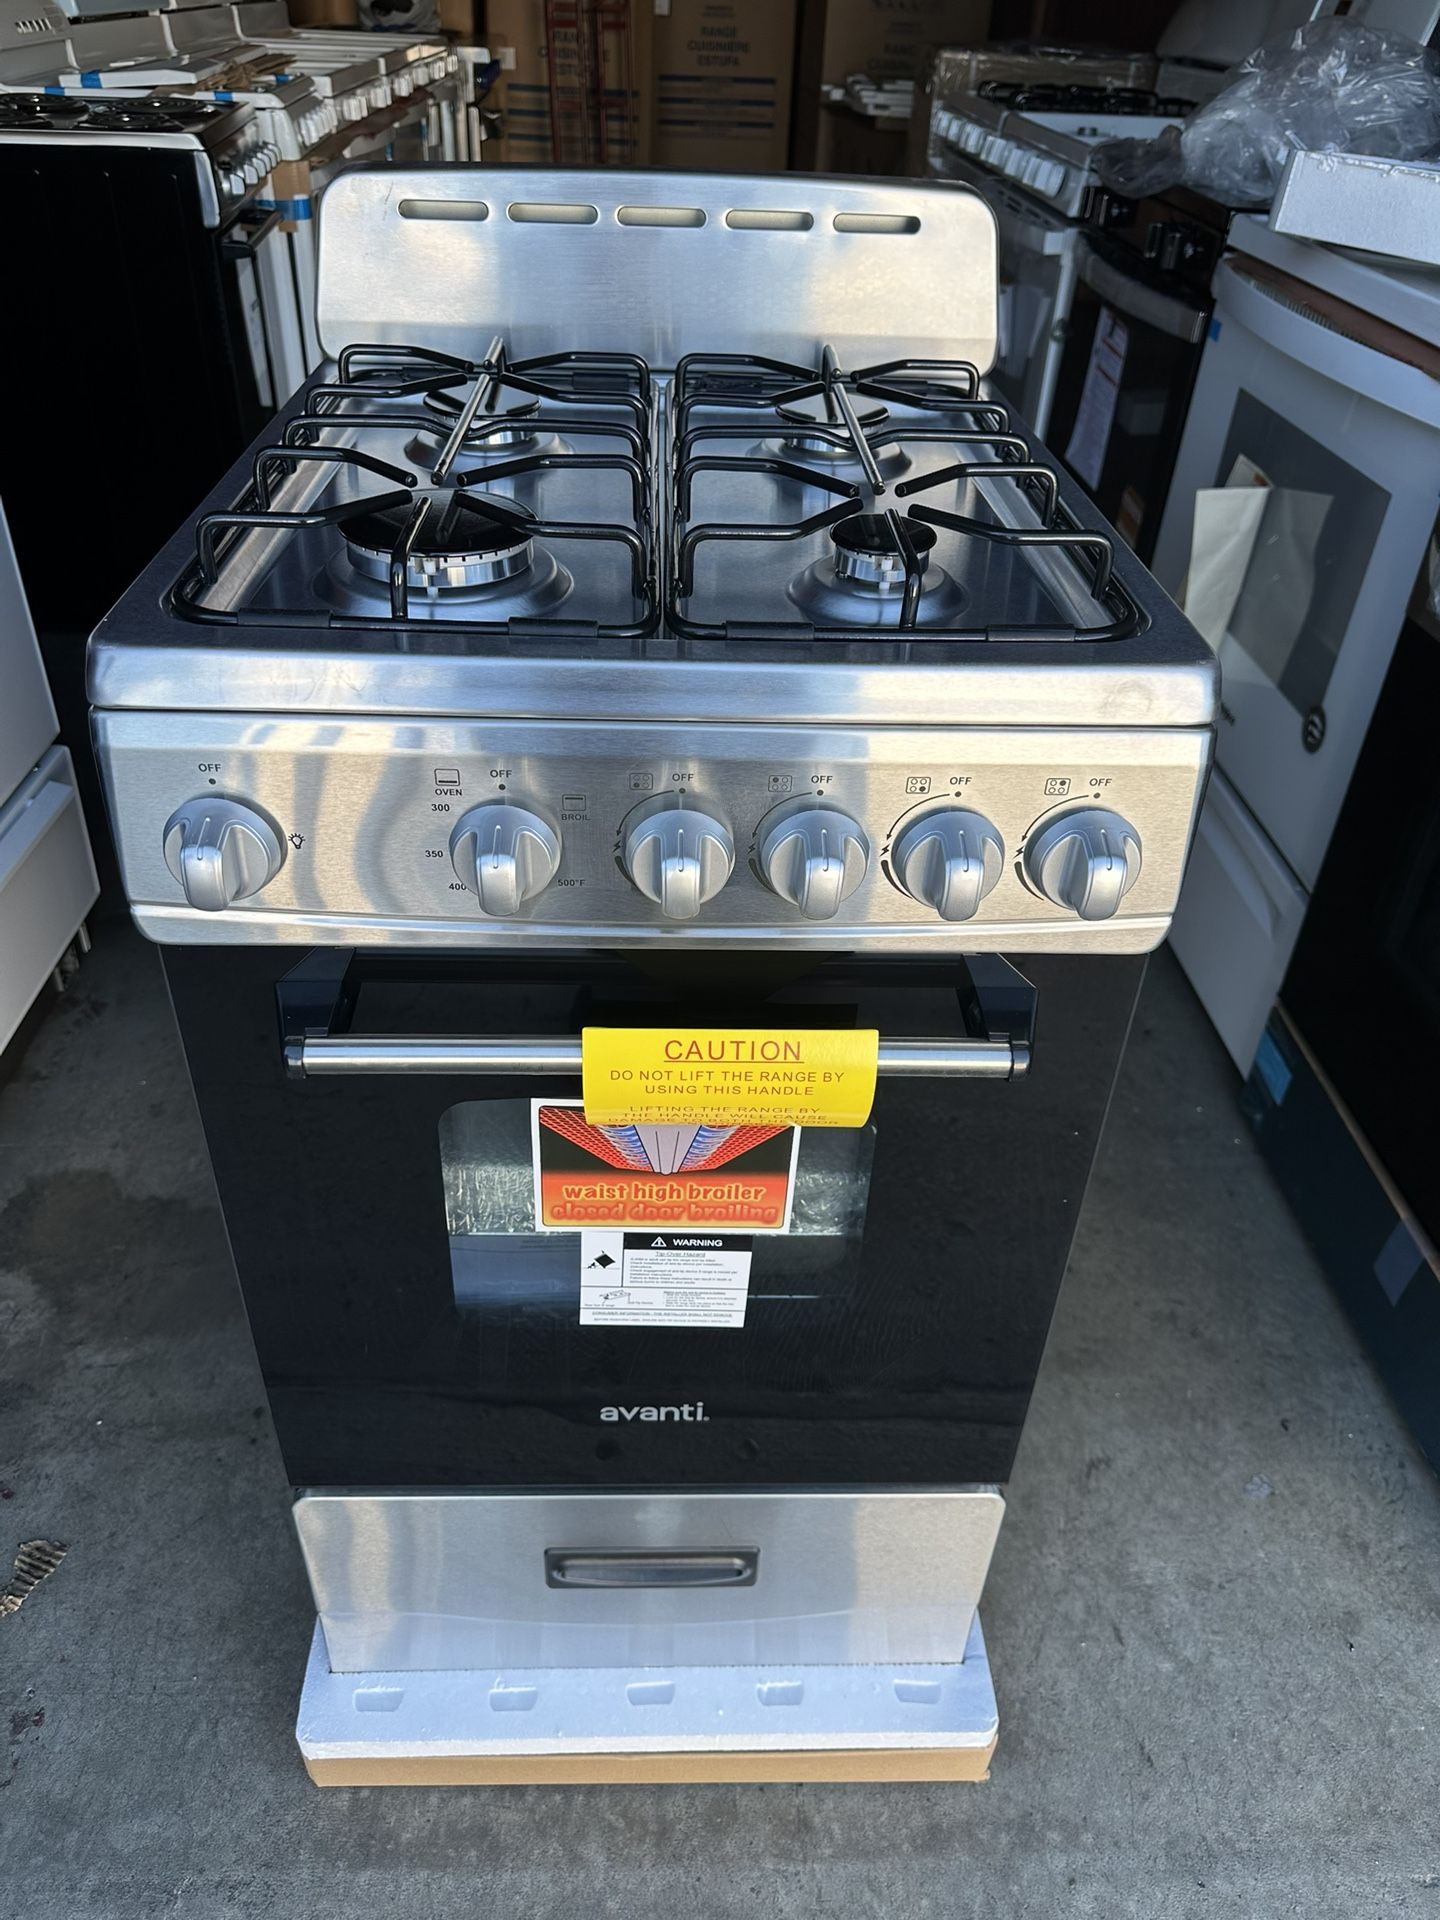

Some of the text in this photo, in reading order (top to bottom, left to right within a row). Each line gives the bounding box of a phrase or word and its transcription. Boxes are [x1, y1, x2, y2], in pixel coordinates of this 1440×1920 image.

[701, 26, 738, 39] RANGE
[198, 763, 221, 772] OFF
[489, 769, 512, 778] OFF
[672, 774, 694, 782] OFF
[811, 775, 833, 784] OFF
[949, 776, 972, 785] OFF
[1089, 778, 1112, 787] OFF
[434, 788, 463, 796] OVEN
[431, 803, 450, 812] 300
[425, 850, 443, 858] 350
[448, 882, 467, 891] 400
[557, 879, 585, 887] 500°F
[664, 1040, 801, 1061] CAUTION
[610, 1070, 844, 1083] DO NOT LIFT THE RANGE BY
[645, 1085, 814, 1096] USING THIS HANDLE
[564, 1182, 765, 1203] waist high broiler
[552, 1203, 777, 1224] closed door broiling
[673, 1238, 723, 1247] WARNING
